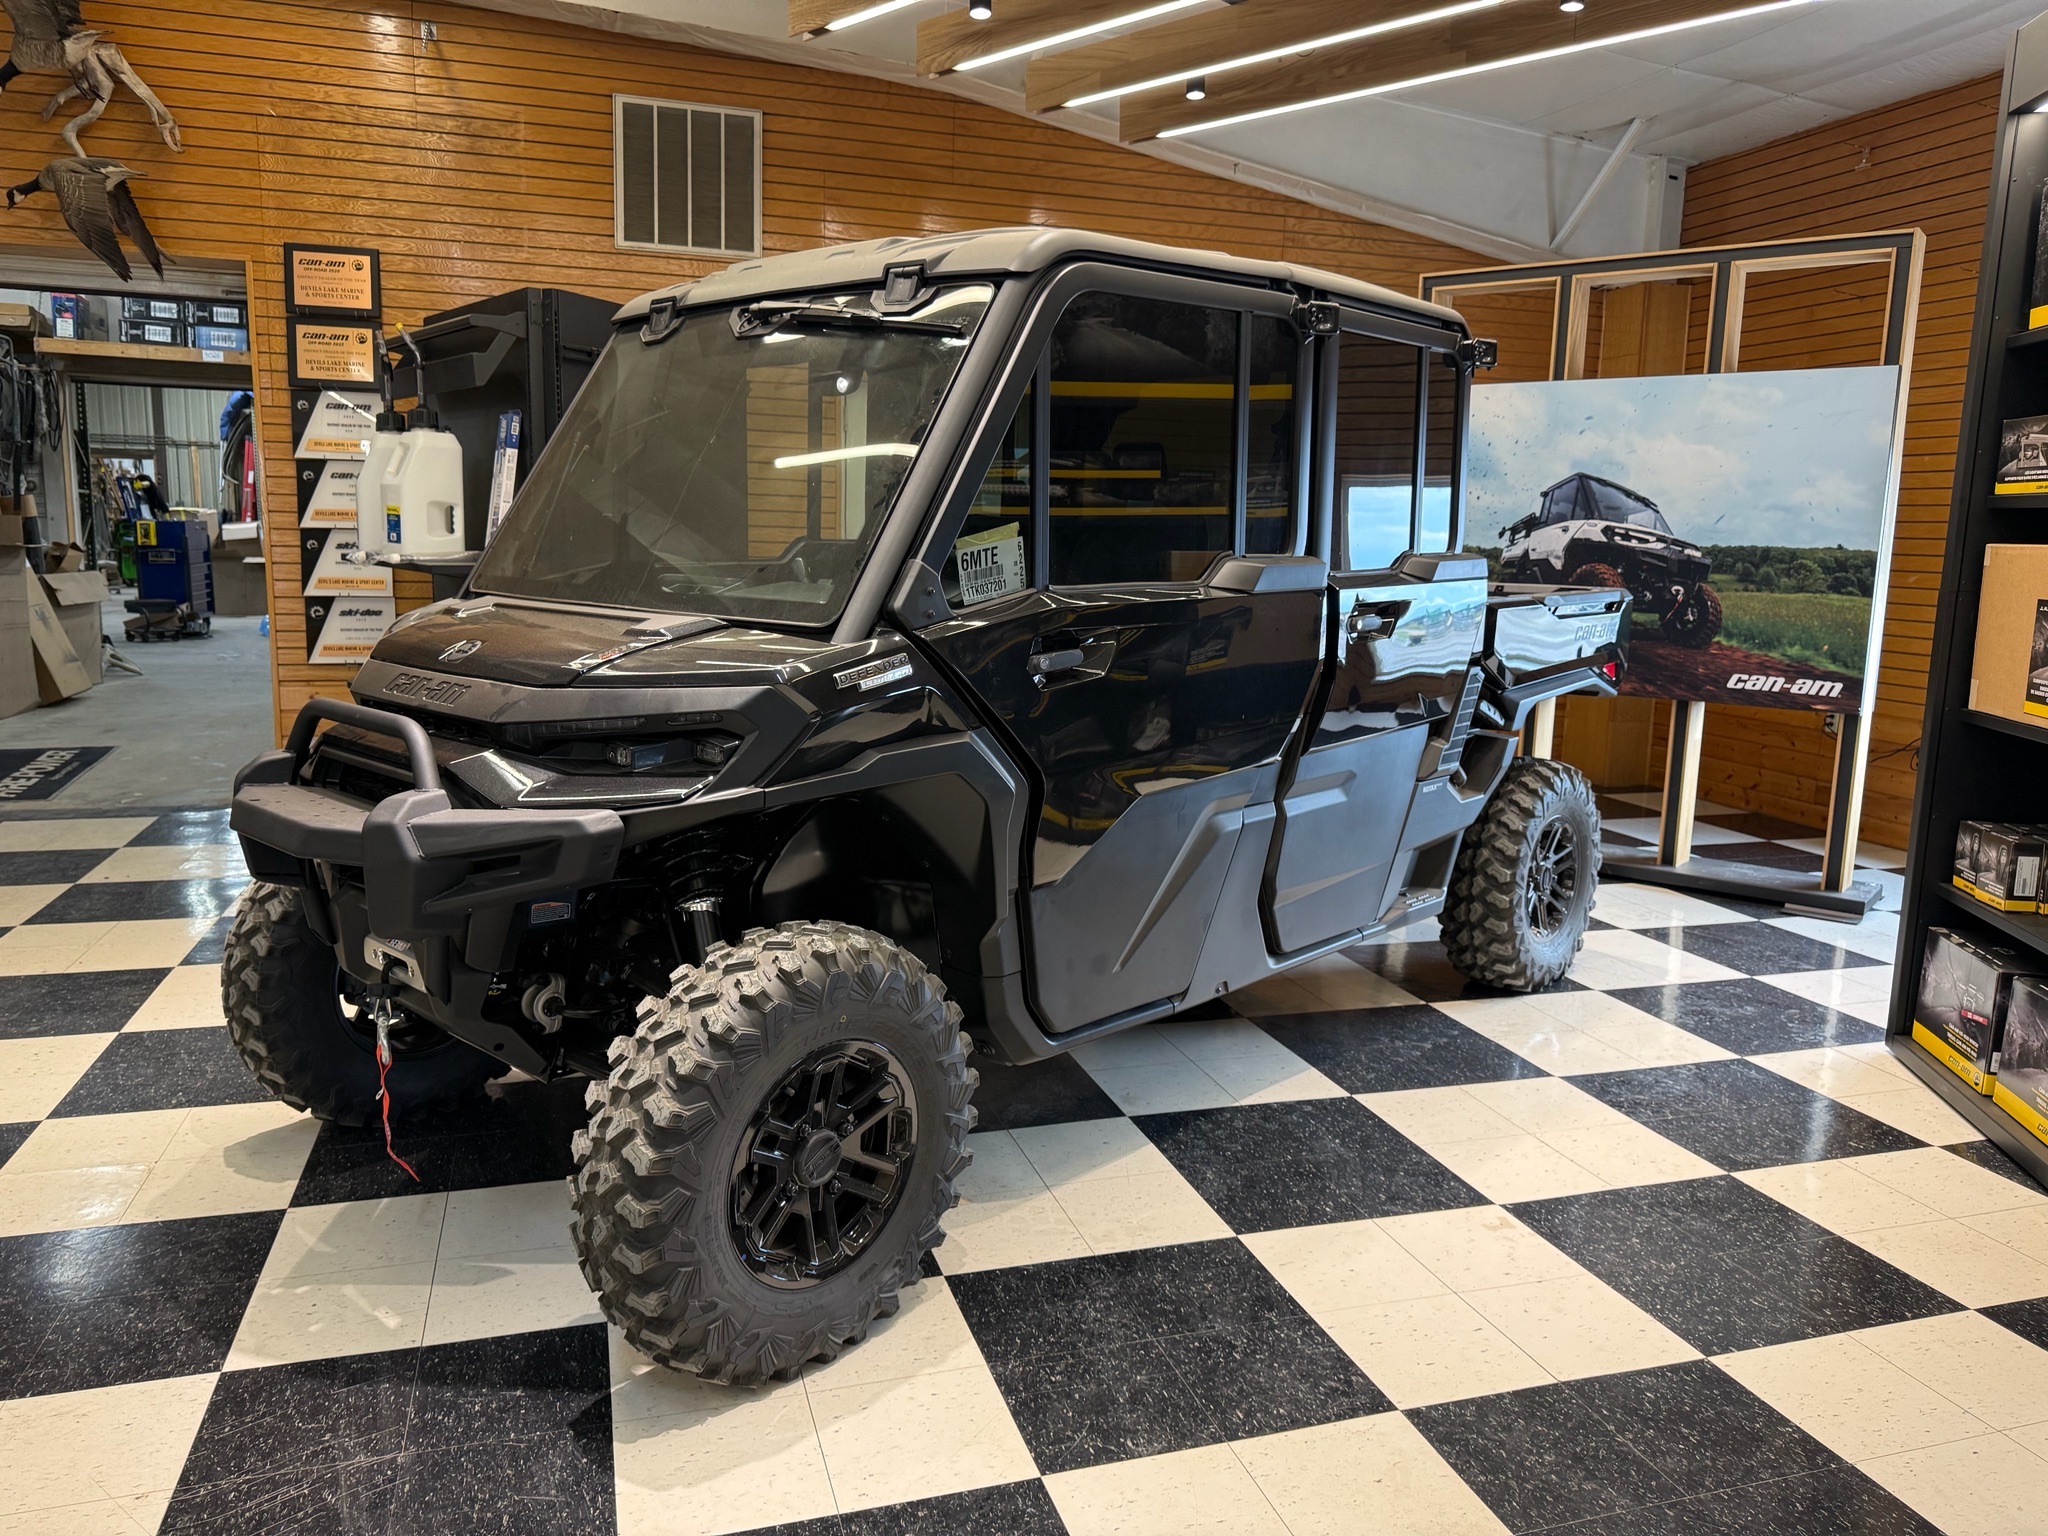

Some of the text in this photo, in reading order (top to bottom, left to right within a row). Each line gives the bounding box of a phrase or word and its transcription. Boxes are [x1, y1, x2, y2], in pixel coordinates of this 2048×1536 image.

[298, 258, 345, 268] can-am
[302, 332, 349, 341] can-am
[325, 402, 372, 411] can-am
[961, 546, 998, 572] 6MTE
[966, 579, 1006, 598] 1TK037201
[840, 655, 908, 685] DEFENDER
[383, 673, 472, 707] can-am
[1727, 673, 1843, 698] can-am
[1948, 1055, 1971, 1076] can-am
